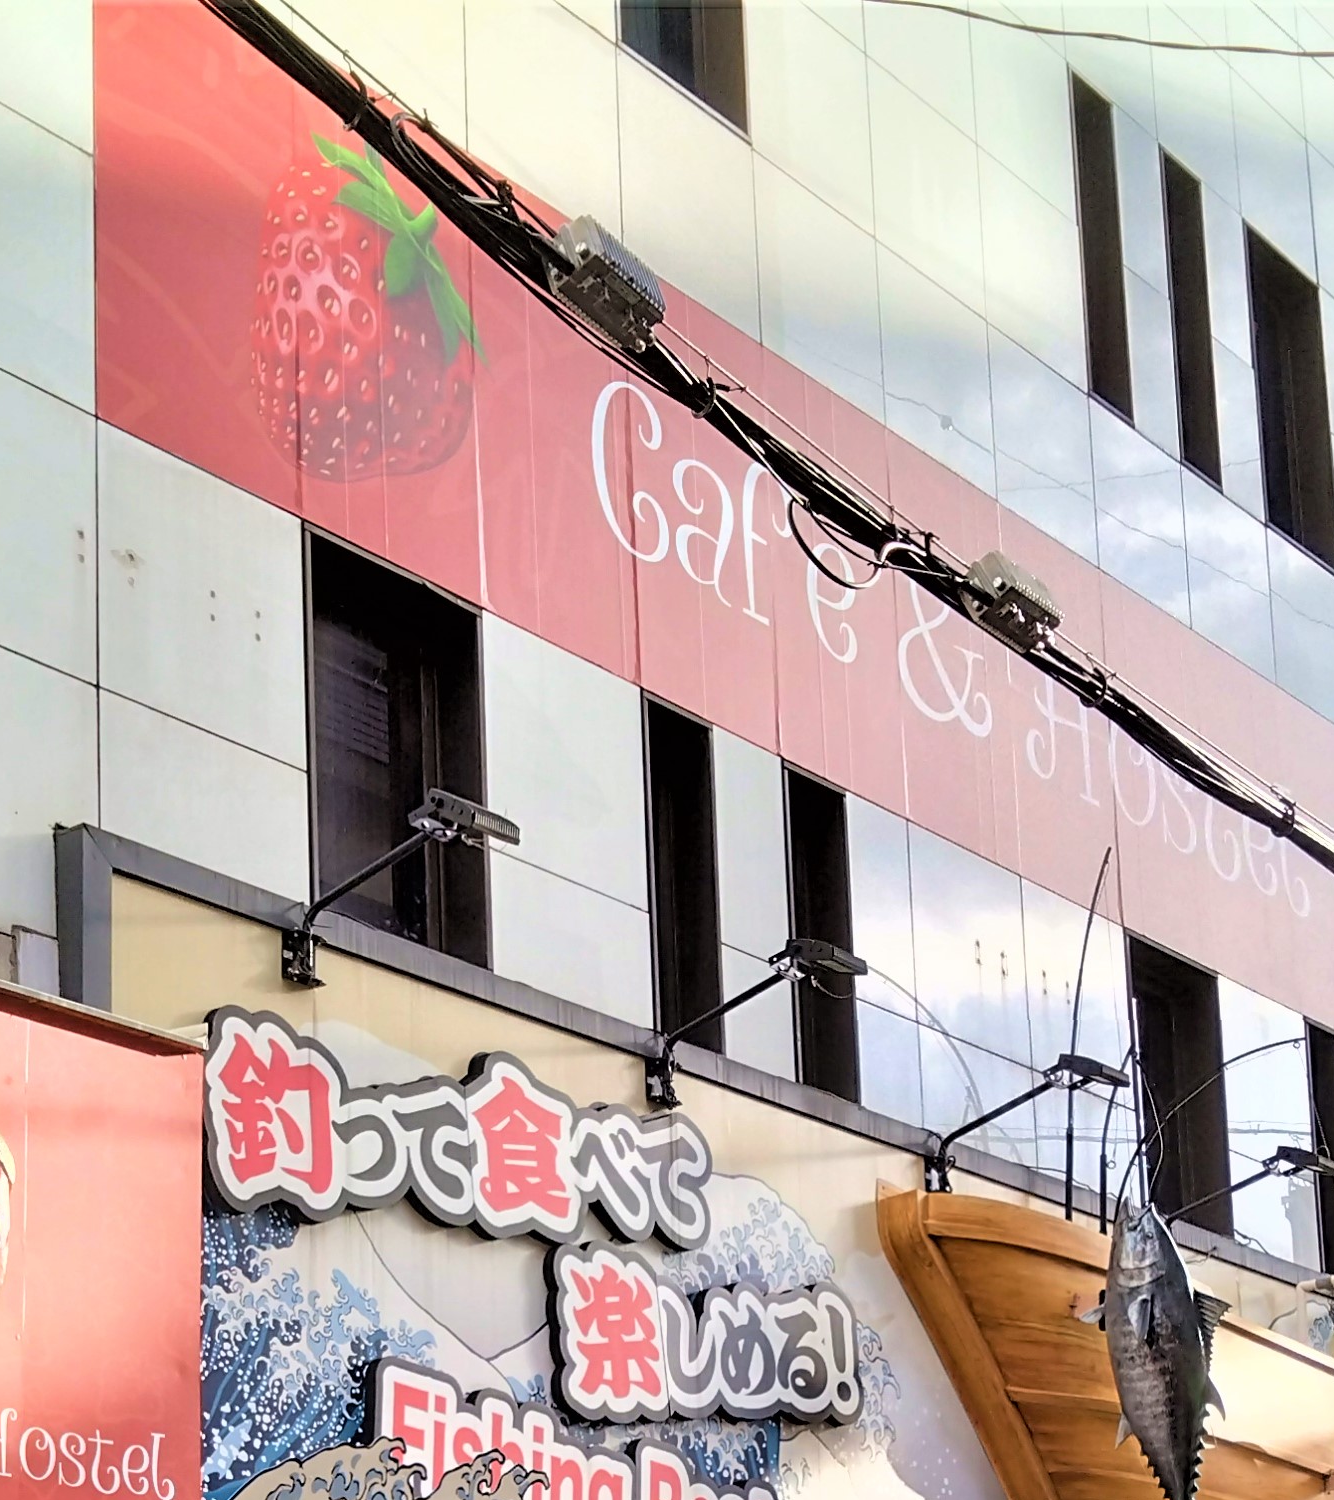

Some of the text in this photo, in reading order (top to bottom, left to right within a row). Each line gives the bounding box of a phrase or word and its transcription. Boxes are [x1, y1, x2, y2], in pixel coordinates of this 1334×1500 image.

[592, 381, 858, 664] Cafe
[217, 1031, 707, 1228] 釣って食べて
[571, 1262, 857, 1402] 楽しめる!
